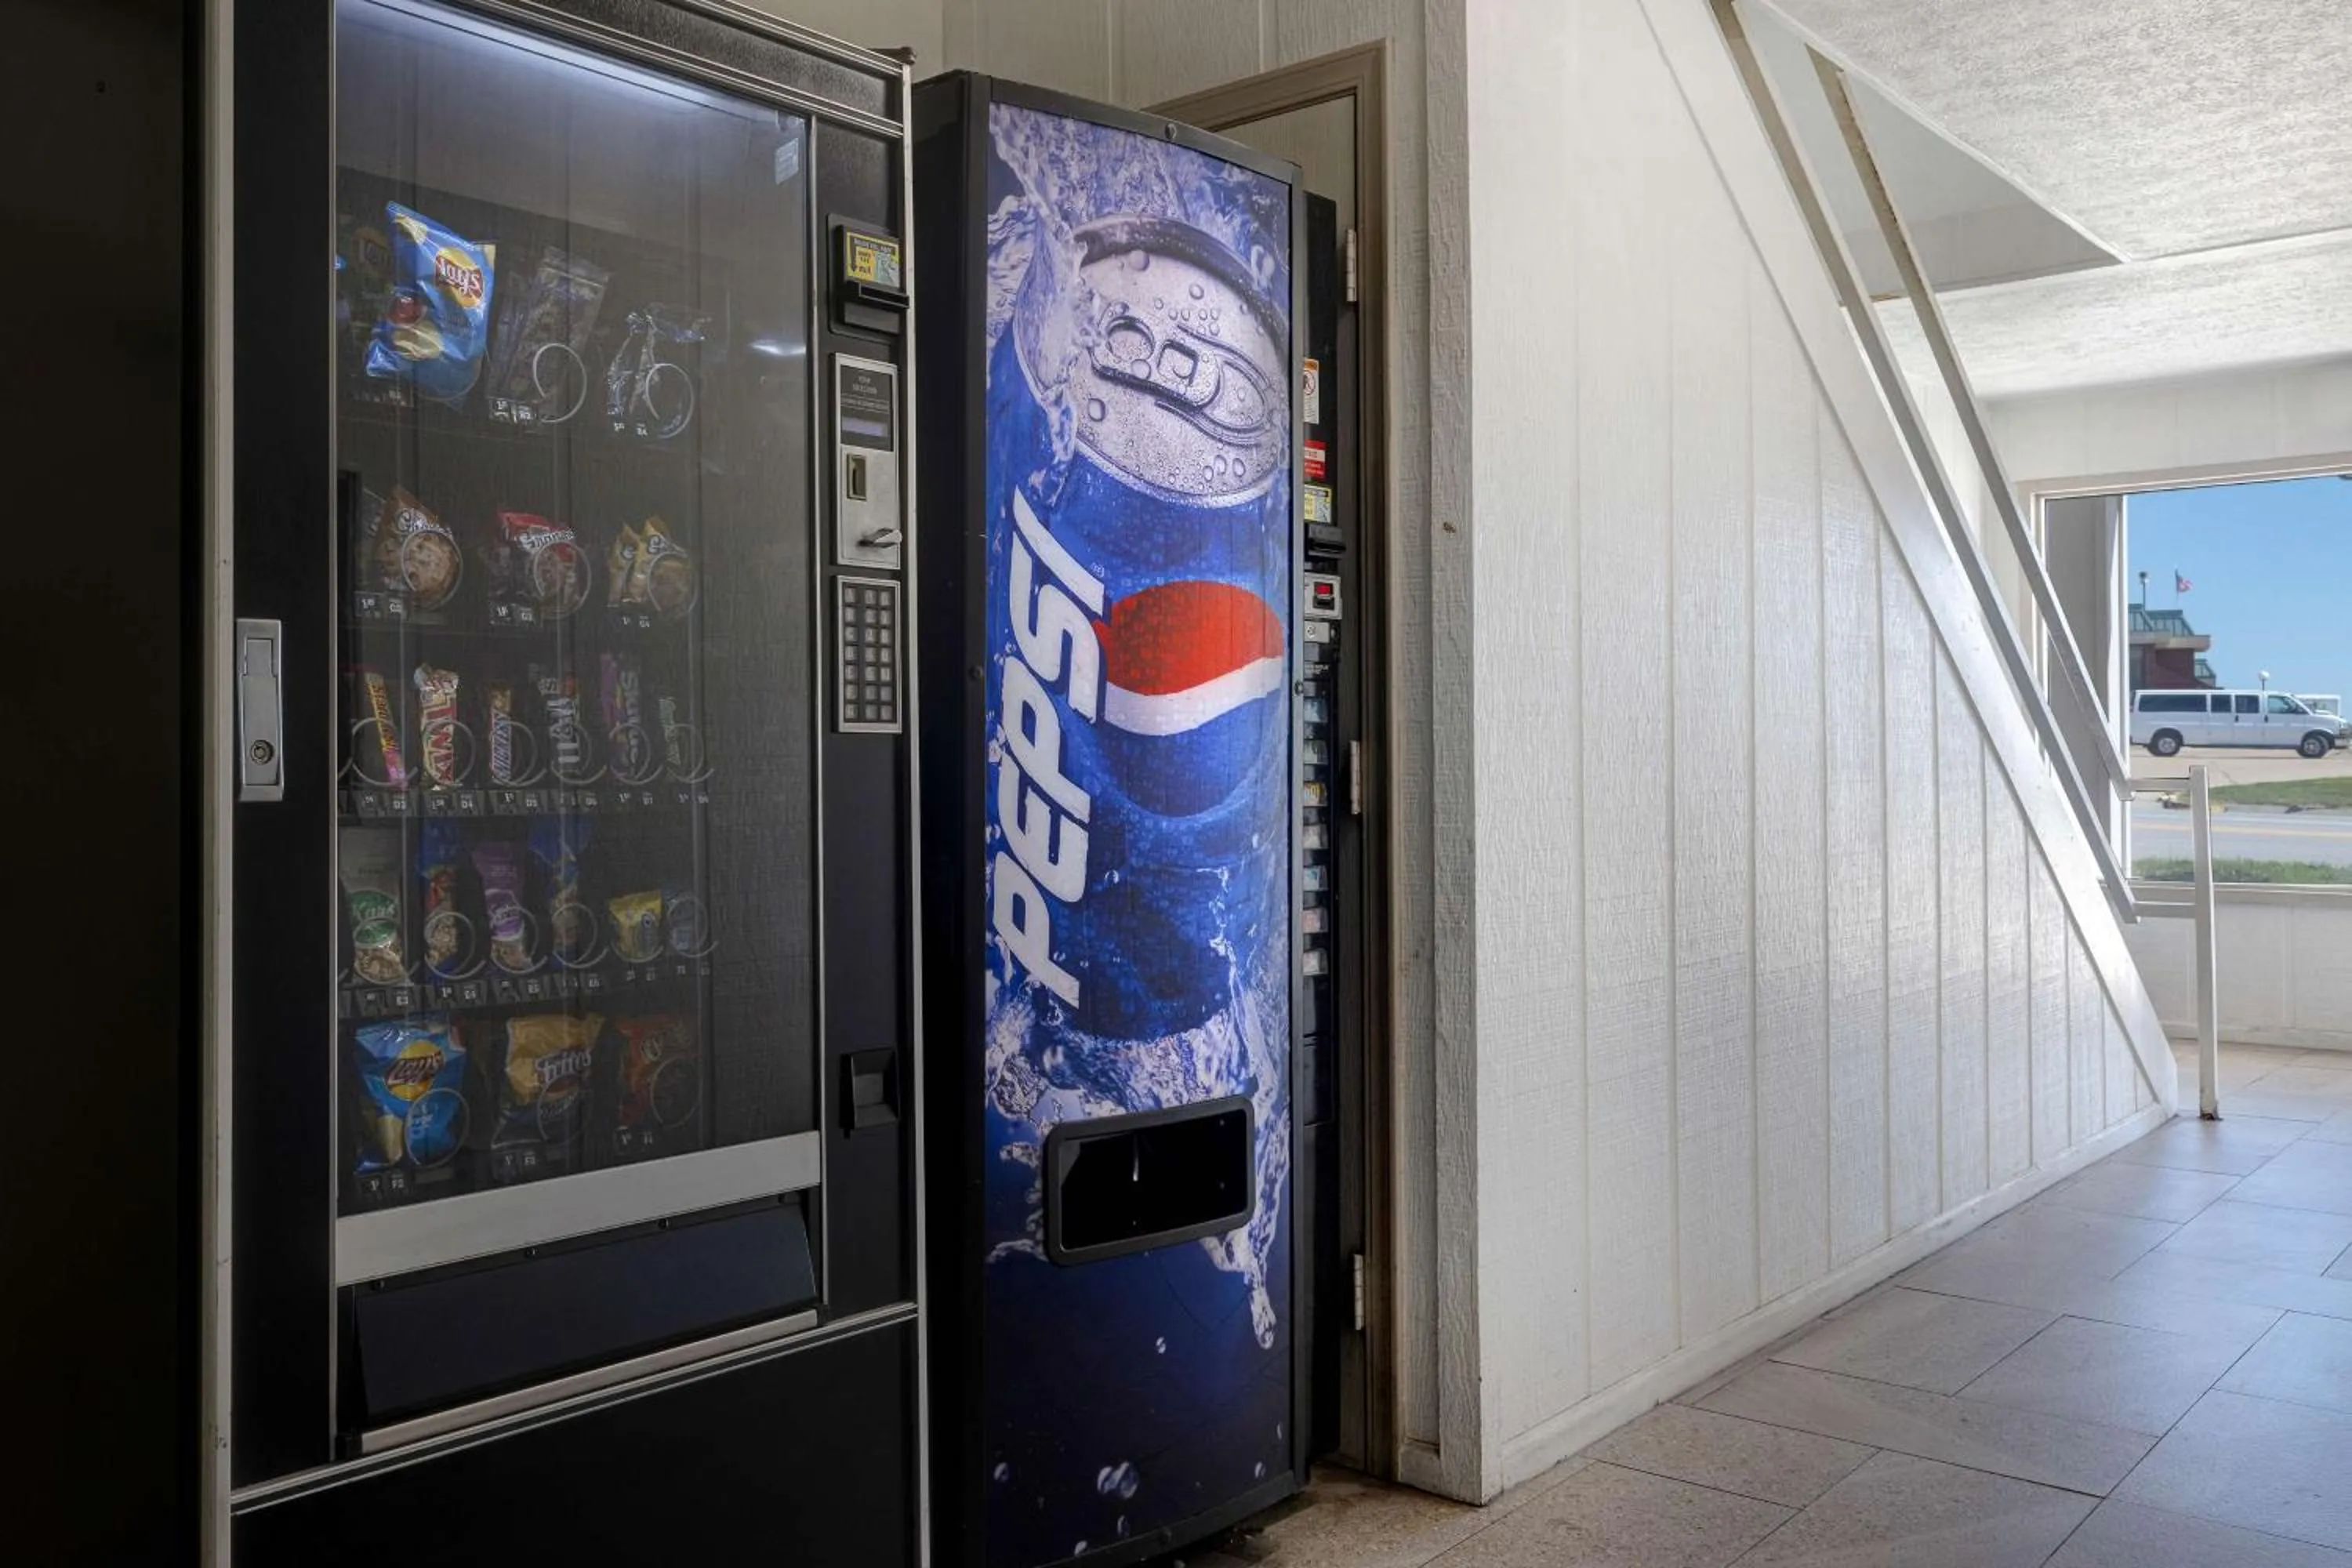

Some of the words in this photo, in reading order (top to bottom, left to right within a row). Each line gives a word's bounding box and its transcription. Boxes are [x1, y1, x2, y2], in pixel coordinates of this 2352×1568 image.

[436, 256, 482, 294] Lay's
[993, 486, 1105, 1009] PEPSI
[387, 1051, 445, 1086] Lay's
[534, 1048, 590, 1083] Fritos
